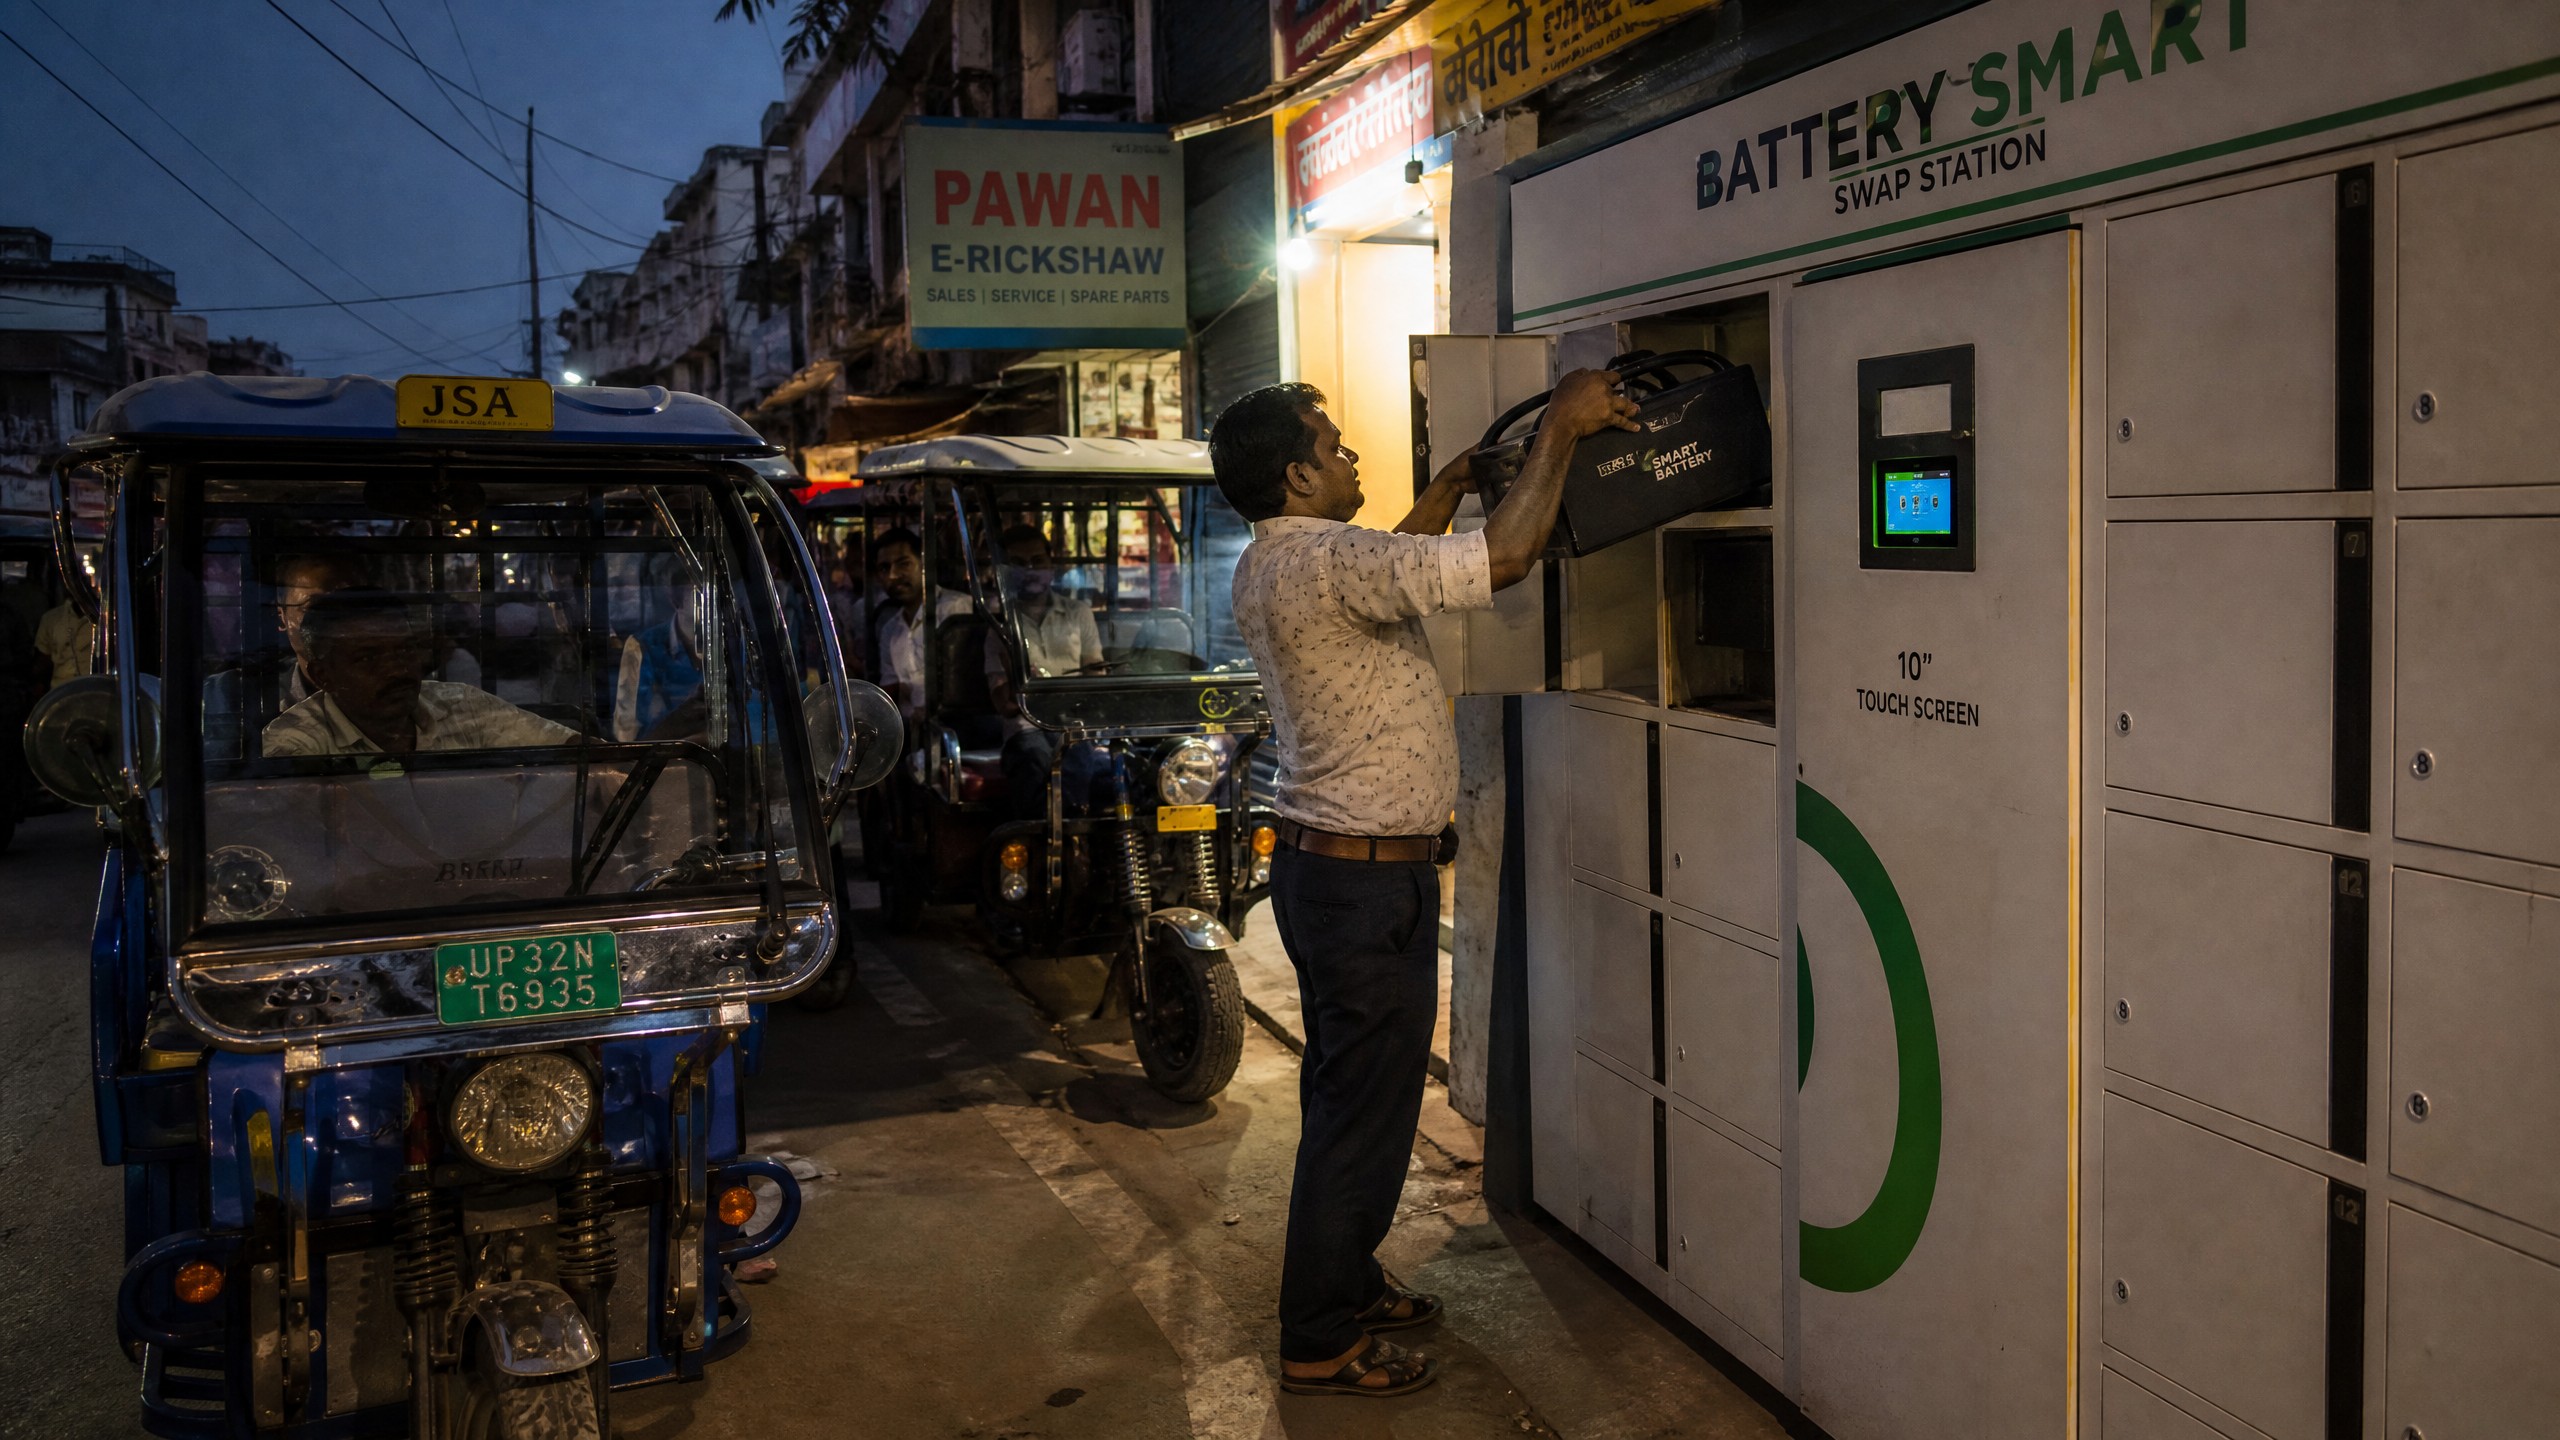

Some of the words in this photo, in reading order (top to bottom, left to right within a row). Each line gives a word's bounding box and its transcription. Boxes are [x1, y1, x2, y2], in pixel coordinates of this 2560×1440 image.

[1697, 69, 1947, 210] BATTERY
[1834, 167, 1911, 214] SWAP
[1919, 129, 2046, 193] STATION
[934, 169, 1160, 229] PAWAN
[931, 244, 1165, 276] E-RICKSHAW
[927, 288, 976, 303] SALES
[991, 289, 1056, 304] SERVICE
[1070, 290, 1119, 304] SPARE
[1123, 290, 1170, 304] PARTS
[423, 385, 518, 418] JSA
[1653, 442, 1698, 469] SMART
[1655, 449, 1713, 481] BATTERY
[1856, 688, 1909, 716] TOUCH
[1913, 696, 1979, 727] SCREEN
[471, 974, 596, 1015] T6935
